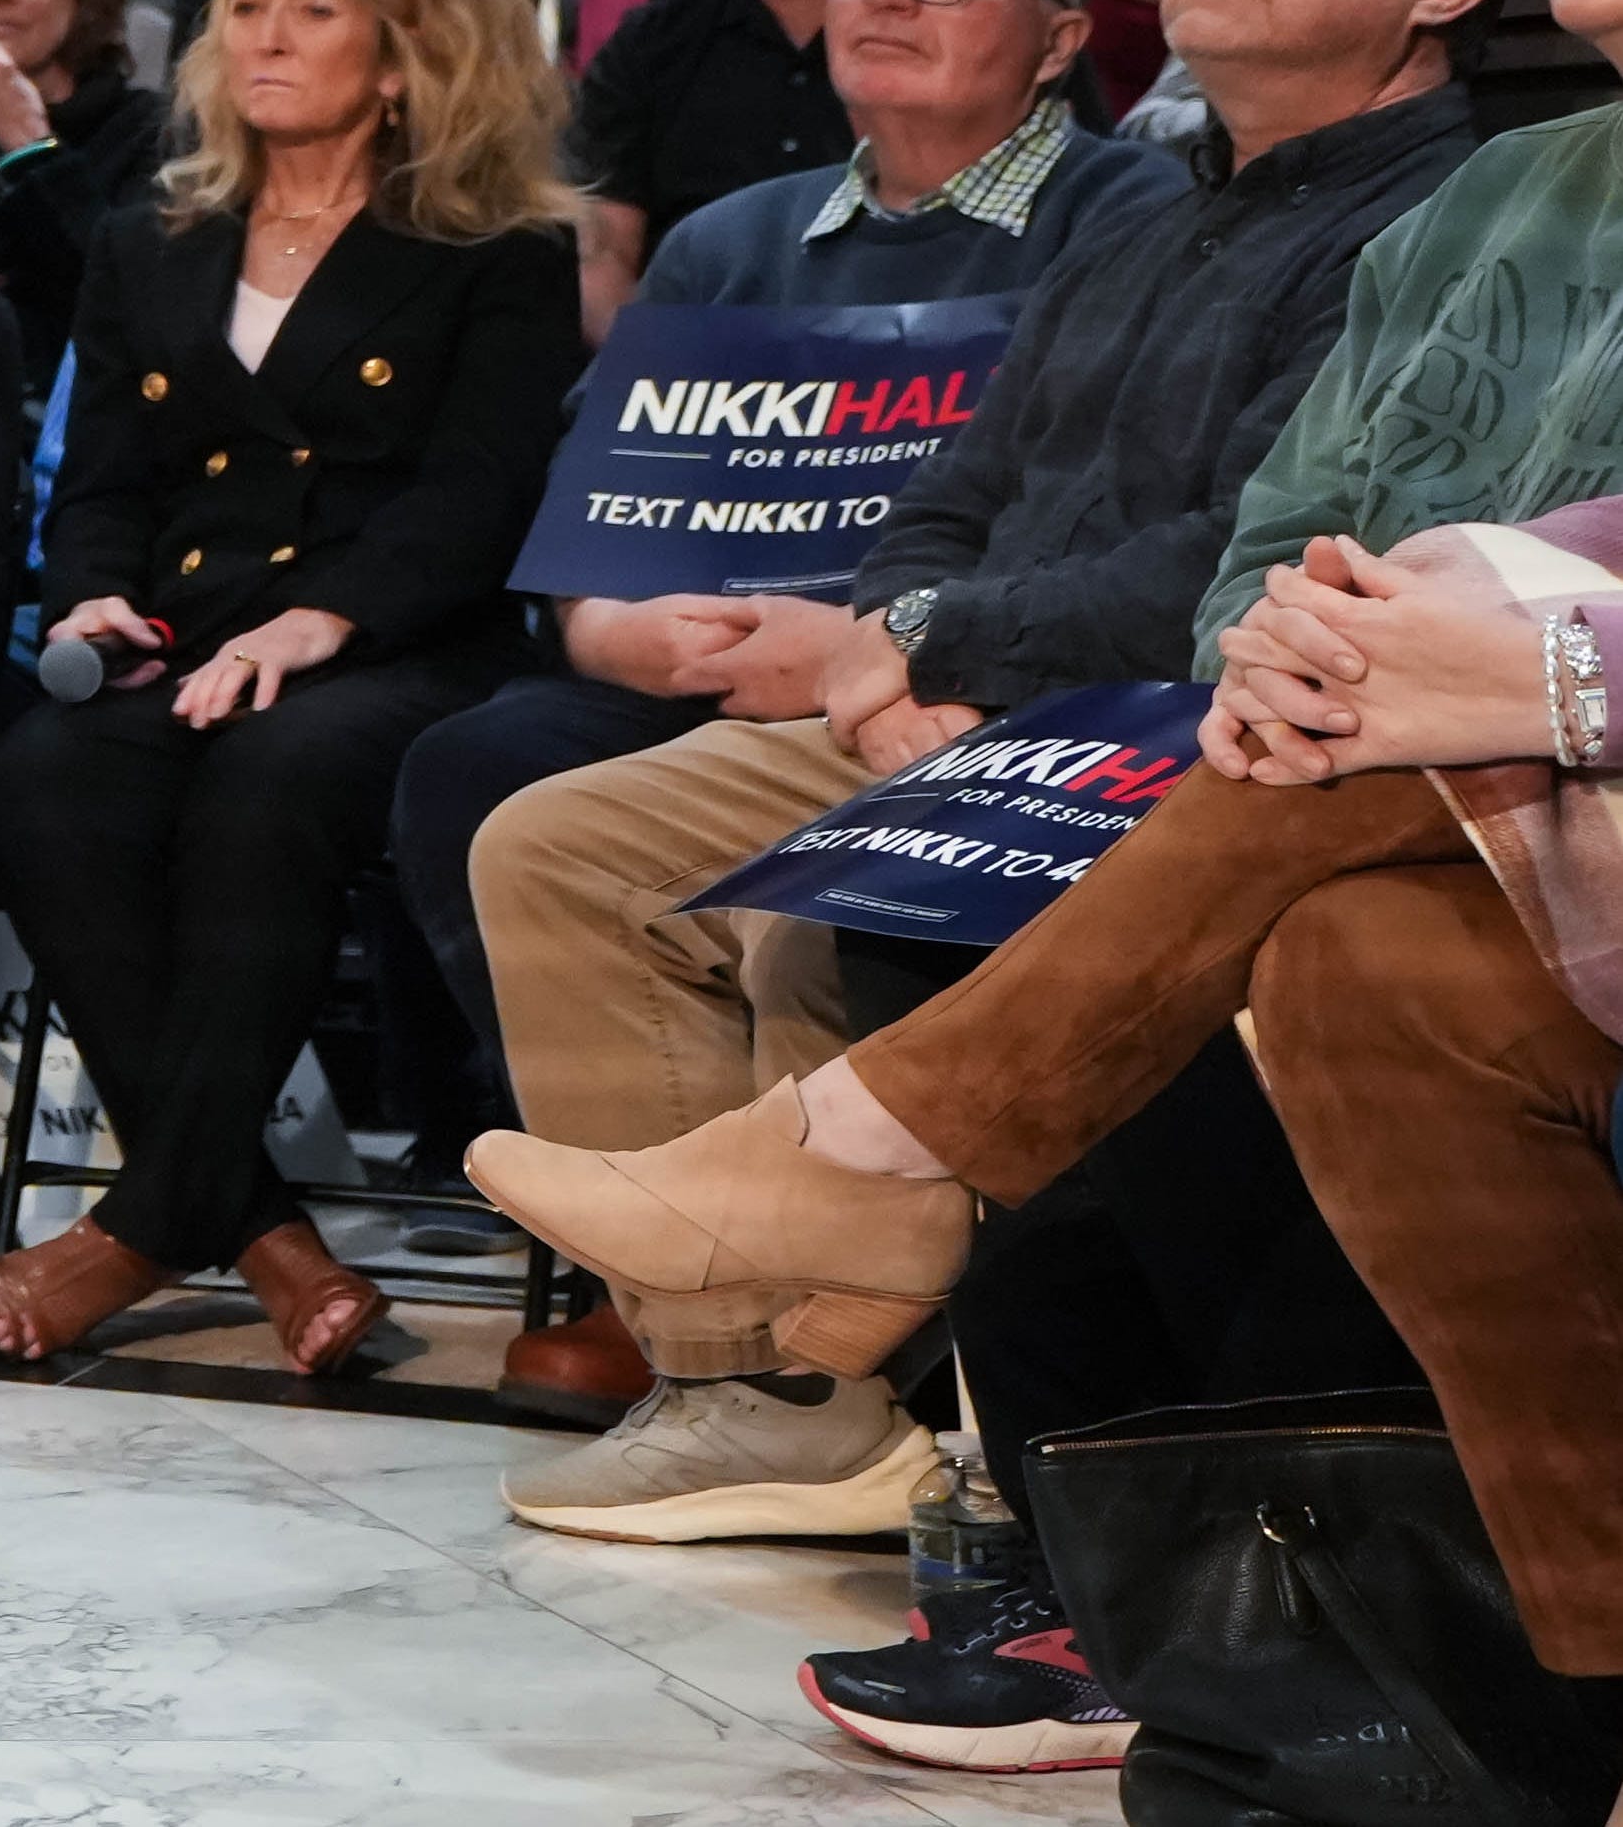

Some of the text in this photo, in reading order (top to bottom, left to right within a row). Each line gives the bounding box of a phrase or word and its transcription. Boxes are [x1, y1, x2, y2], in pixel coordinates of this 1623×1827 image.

[617, 367, 998, 438] NIKKIHAL
[727, 437, 943, 468] FOR PRESIDENT
[585, 491, 891, 534] TEXT NIKKI TO
[946, 788, 1140, 831] FOR PRESIDEN
[777, 826, 865, 855] TEXT
[851, 827, 998, 869] NIKKI
[981, 848, 1054, 878] TO
[41, 1108, 109, 1139] NIK
